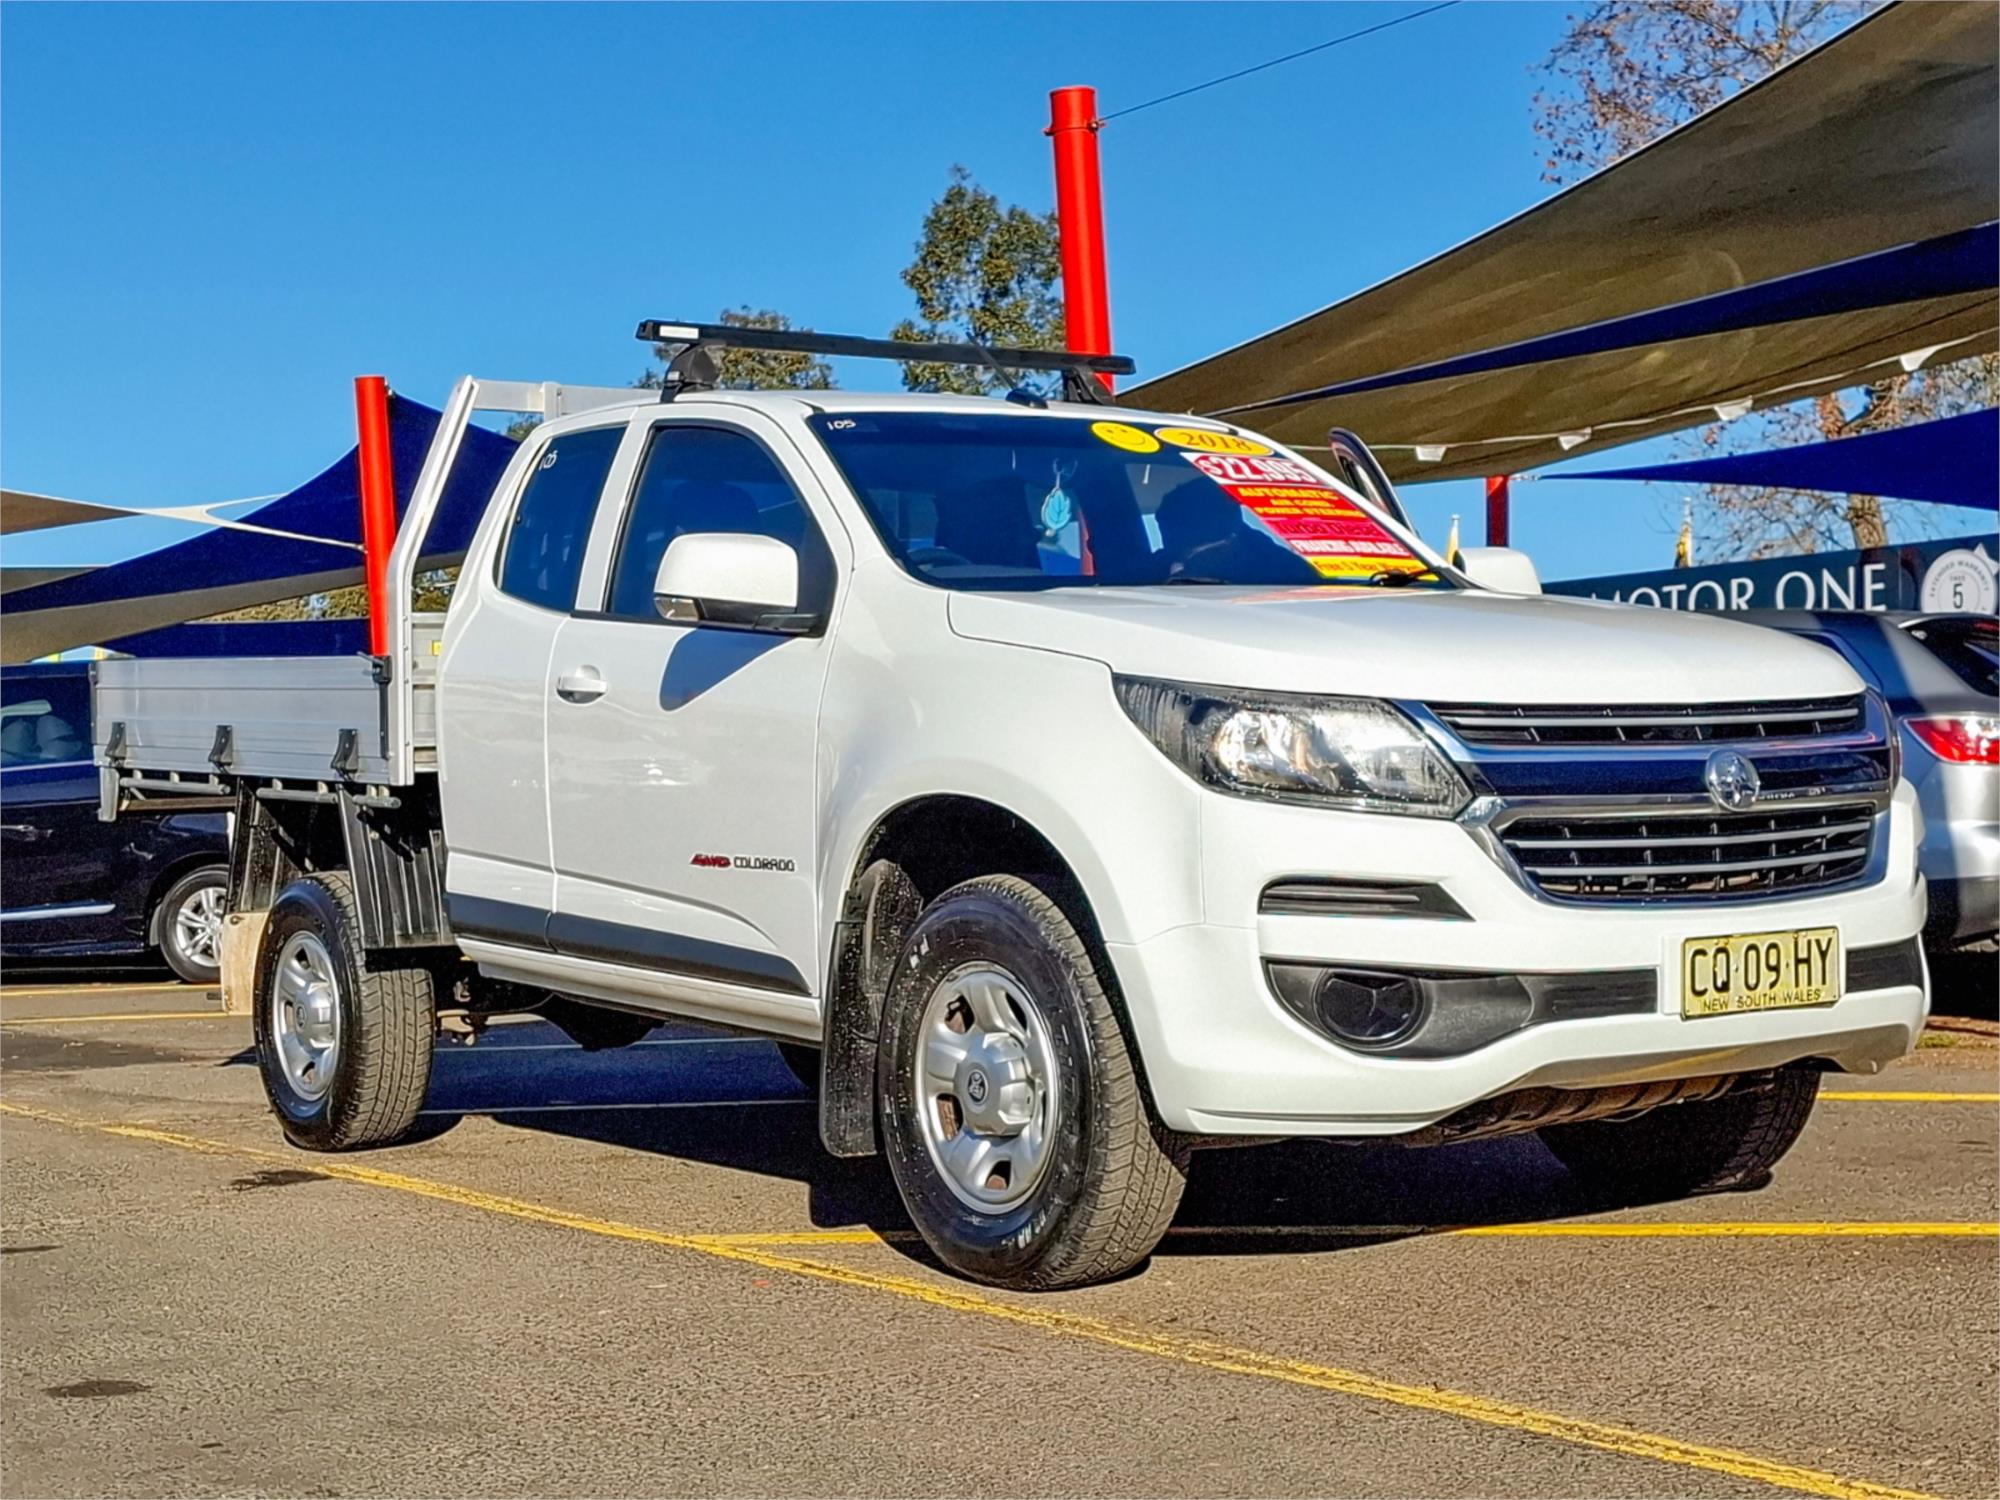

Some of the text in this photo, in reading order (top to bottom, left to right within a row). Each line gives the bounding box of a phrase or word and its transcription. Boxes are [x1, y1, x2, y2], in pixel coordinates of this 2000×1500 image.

[1179, 431, 1252, 452] 2018
[1199, 455, 1319, 484] $22,995
[1237, 487, 1339, 500] AUTOMATIC
[1591, 563, 1887, 612] OTOR ONE
[1952, 583, 1964, 609] 5
[733, 856, 795, 872] COLORADO
[1703, 988, 1821, 1012] NEW SOUTH WALES
